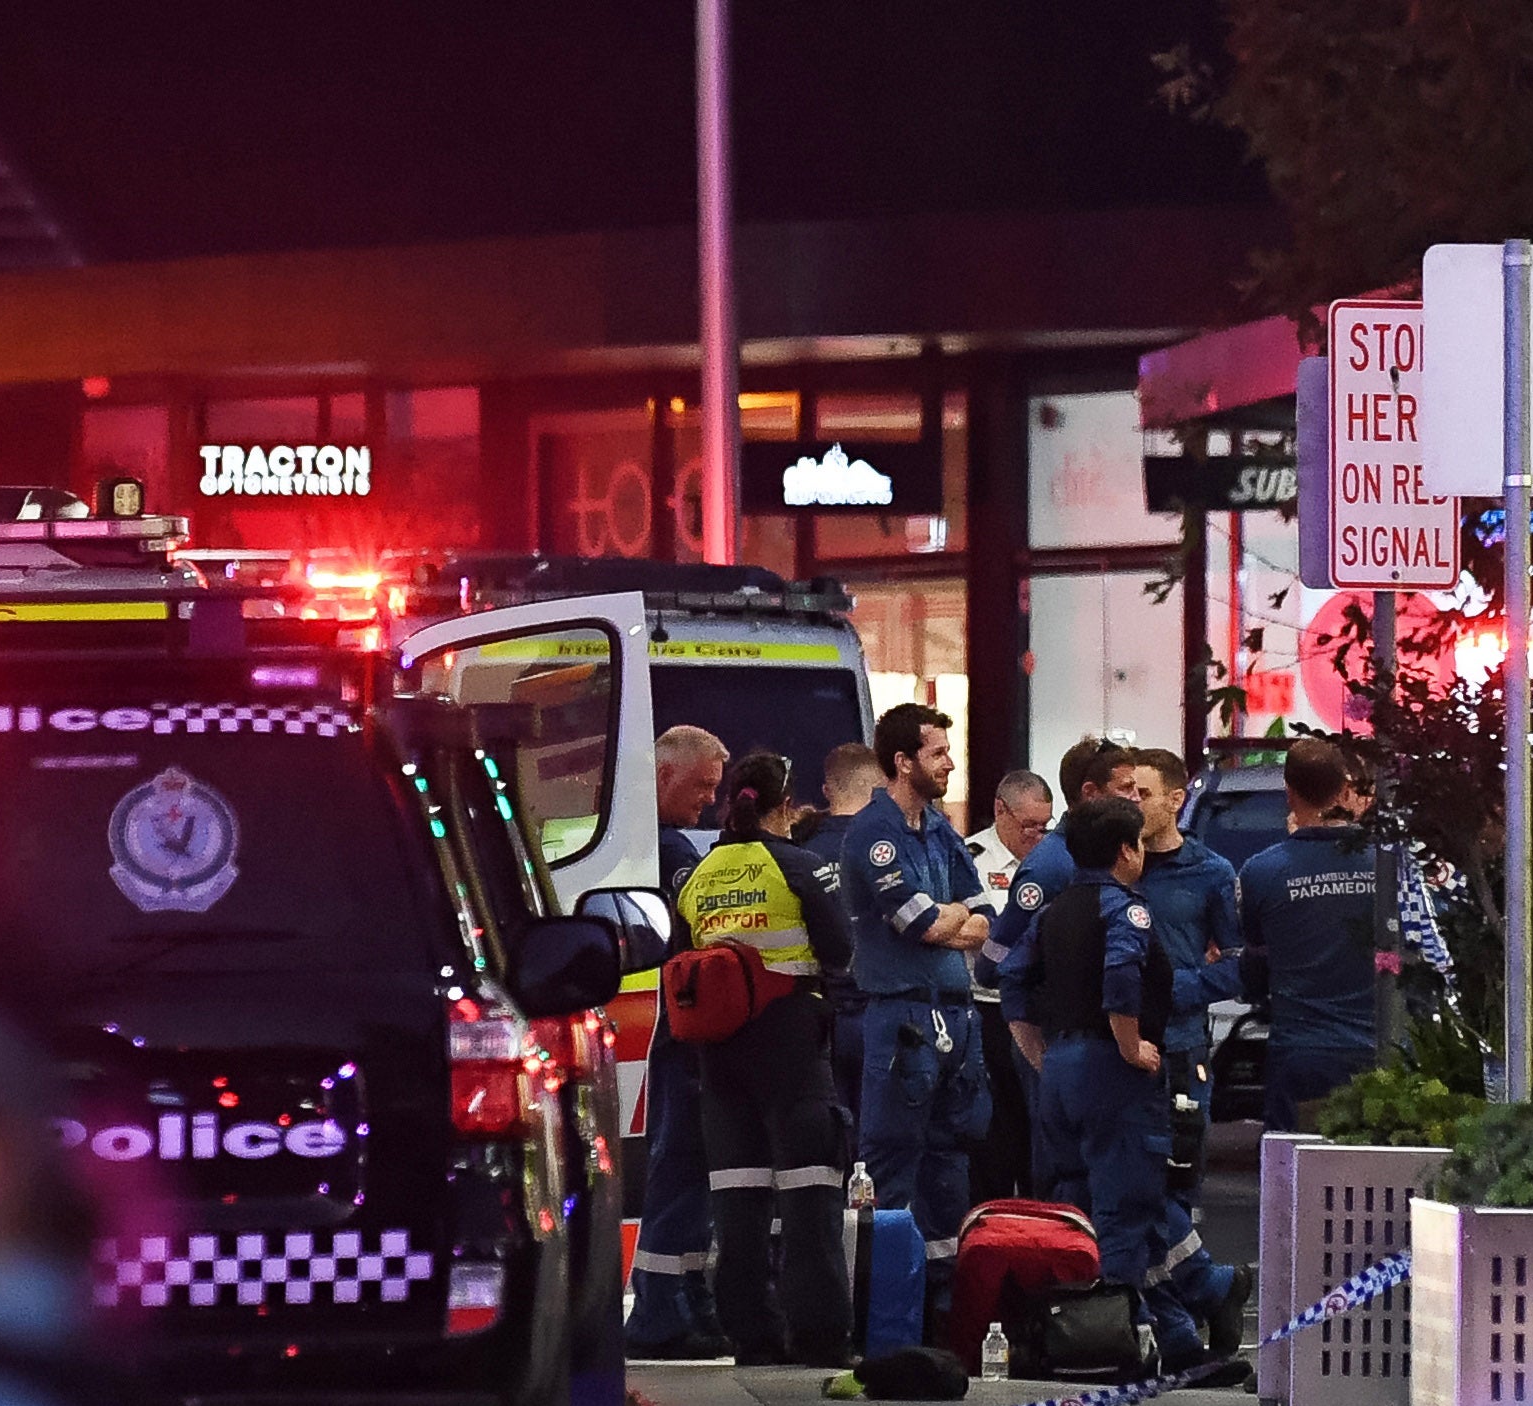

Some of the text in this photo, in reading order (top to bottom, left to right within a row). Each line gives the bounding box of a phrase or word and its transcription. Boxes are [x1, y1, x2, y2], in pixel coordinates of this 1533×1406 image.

[1349, 323, 1424, 372] STO
[1347, 393, 1418, 441] HER
[200, 445, 371, 477] TRACTON
[1342, 463, 1382, 504] ON
[1341, 526, 1451, 567] SIGNAL
[1314, 871, 1376, 884] AMBULANC
